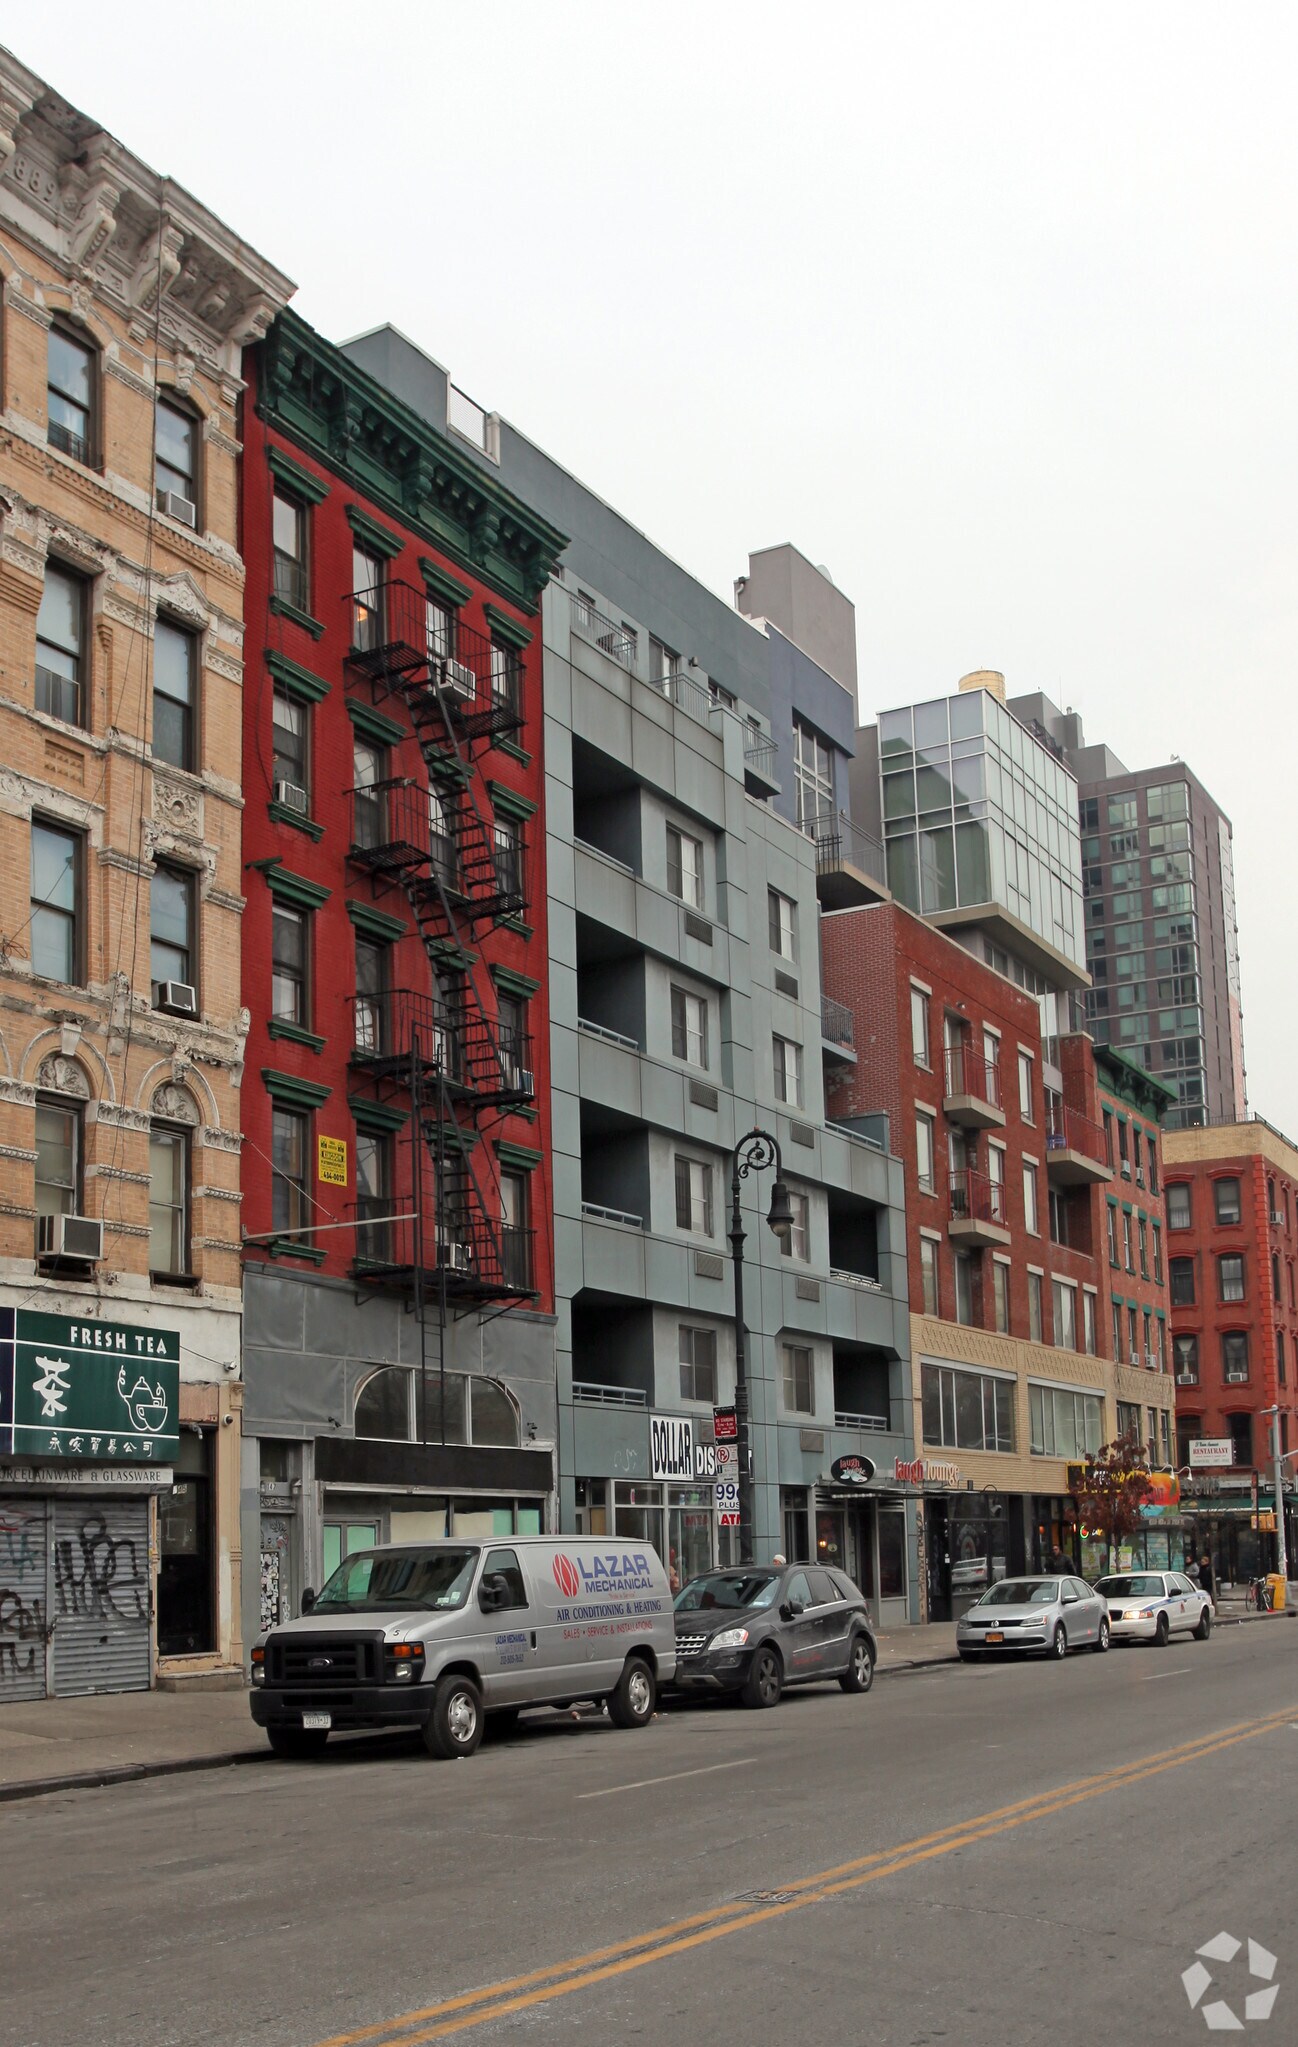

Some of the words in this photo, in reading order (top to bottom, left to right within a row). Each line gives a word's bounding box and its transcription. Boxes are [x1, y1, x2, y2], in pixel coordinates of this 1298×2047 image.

[71, 1326, 126, 1350] FRESH
[135, 1336, 167, 1355] TEA
[32, 1356, 71, 1417] 茶
[653, 1419, 692, 1475] DOLLAR
[1193, 1447, 1229, 1455] RESTAURANT
[840, 1458, 860, 1470] laugh
[894, 1456, 924, 1485] laugh
[924, 1458, 960, 1486] lounge
[103, 1470, 161, 1482] GLASSWARE
[577, 1554, 650, 1579] LAZAR
[585, 1578, 654, 1594] MECHANICAL
[556, 1608, 570, 1622] AIR
[573, 1602, 625, 1620] CONDITIONING
[626, 1602, 632, 1614] &
[634, 1600, 662, 1614] HEATING
[563, 1628, 580, 1640] SALES
[587, 1625, 609, 1638] SERVICE
[610, 1623, 615, 1634] &
[617, 1620, 653, 1634] INSTALLATIONS
